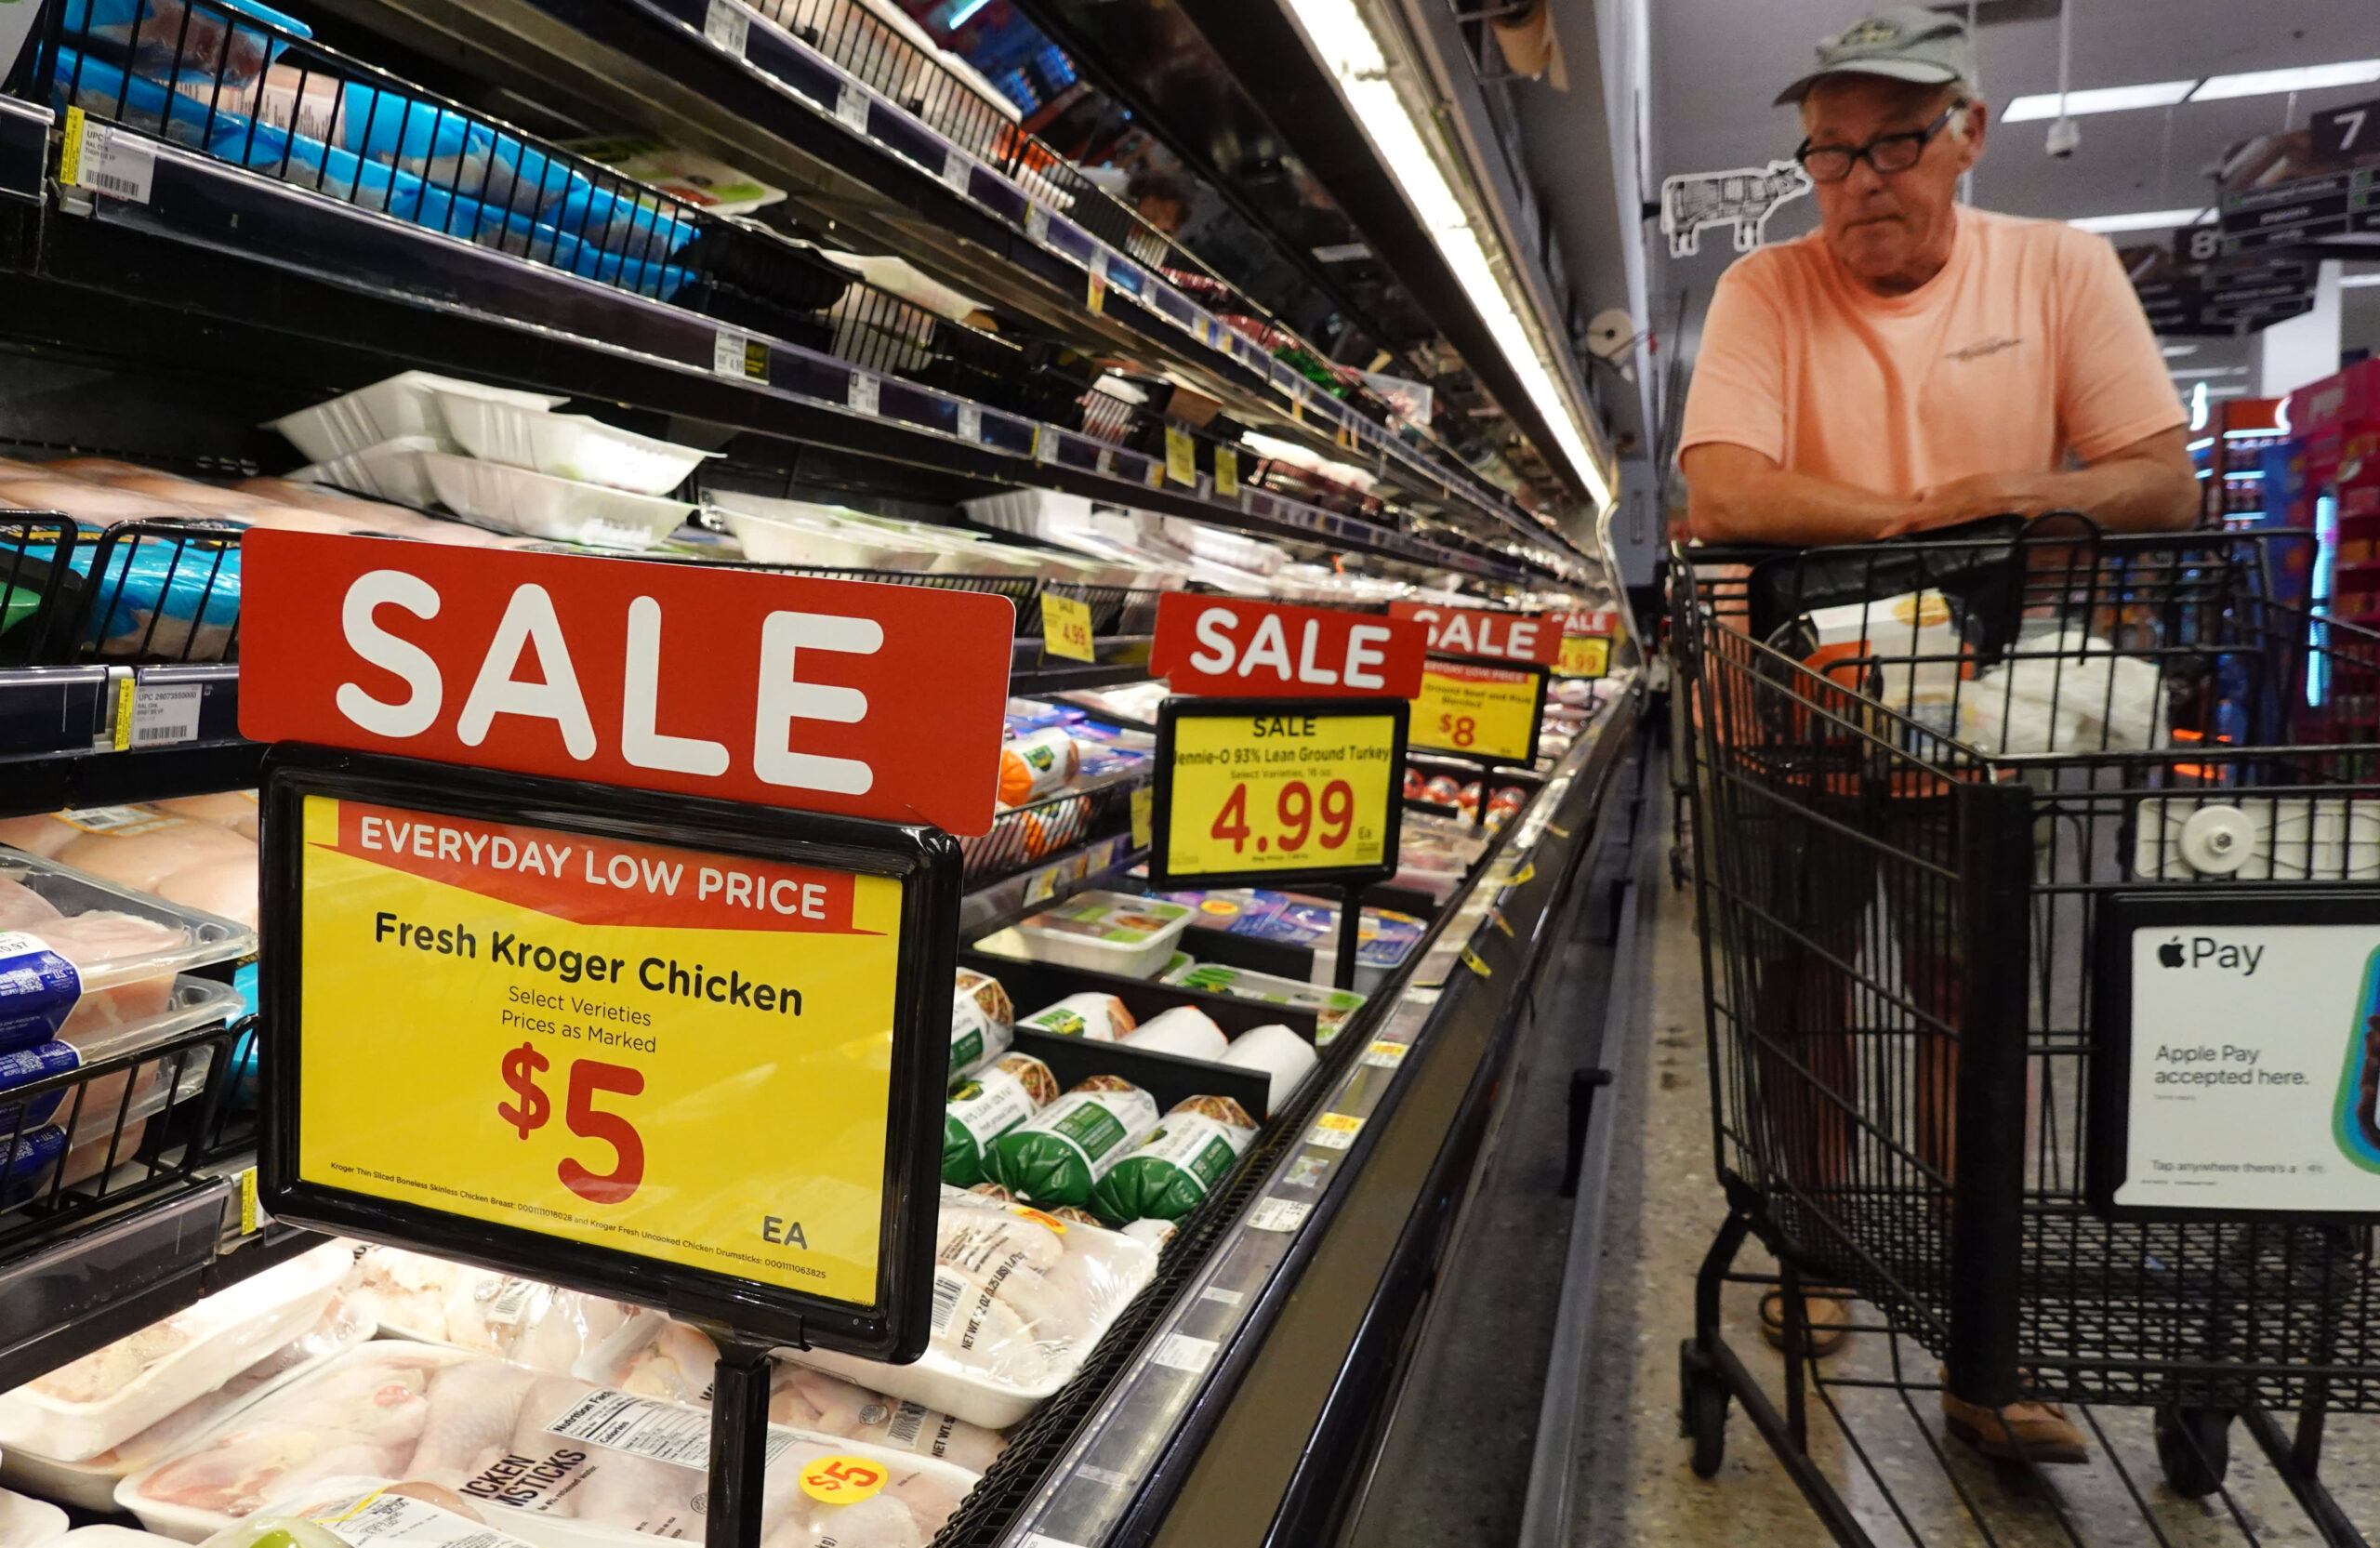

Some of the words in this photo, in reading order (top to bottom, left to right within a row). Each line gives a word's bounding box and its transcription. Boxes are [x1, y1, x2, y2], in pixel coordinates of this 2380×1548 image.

[2333, 110, 2366, 150] 7
[2190, 231, 2217, 259] 8
[1190, 607, 1392, 689] SALE
[139, 693, 153, 701] UPC
[337, 570, 884, 795] SALE
[1252, 717, 1317, 737] SALE
[1439, 713, 1474, 747] $8
[1234, 748, 1261, 763] 93%
[1265, 748, 1295, 762] Lean
[1299, 746, 1344, 762] Ground
[1349, 745, 1390, 762] Turkey
[1210, 779, 1354, 853] 4.99
[362, 815, 572, 879] EVERYDAY
[586, 850, 683, 896] LOW
[699, 867, 826, 920] PRICE
[376, 911, 476, 959] Fresh
[491, 931, 625, 984] Kroger
[639, 957, 802, 1016] Chicken
[2192, 937, 2265, 976] Pay
[509, 986, 564, 1011] Select
[572, 997, 651, 1026] Verieties
[502, 1010, 556, 1035] Prices
[562, 1025, 581, 1039] as
[588, 1025, 656, 1053] Marked
[2155, 1045, 2216, 1065] Apple
[2222, 1045, 2260, 1065] Pay
[2154, 1069, 2253, 1088] accepted
[2258, 1069, 2310, 1086] here.
[497, 1041, 645, 1205] $5
[2152, 1159, 2174, 1172] Tap
[2177, 1162, 2240, 1174] anywhere
[2242, 1163, 2285, 1174] there's
[331, 1162, 354, 1173] Kroger
[357, 1167, 372, 1177] Thin
[373, 1171, 395, 1183] Sliced
[397, 1176, 428, 1190] Boneless
[430, 1183, 458, 1196] Skinless
[460, 1190, 489, 1203] Chicken
[491, 1197, 515, 1209] Breast:
[574, 1216, 588, 1225] and
[590, 1220, 616, 1232] Kroger
[618, 1225, 640, 1238] Fresh
[641, 1231, 681, 1247] Uncooked
[682, 1239, 714, 1253] Chicken
[716, 1247, 762, 1265] Drumsticks:
[762, 1215, 807, 1250] EA
[961, 1330, 974, 1351] NET
[969, 1317, 982, 1334] WT.
[979, 1293, 992, 1308] OZ
[996, 1261, 1012, 1281] LBS)
[553, 1400, 595, 1433] Nutrition
[599, 1421, 629, 1444] Calories
[937, 1423, 953, 1442] WT.
[932, 1440, 947, 1458] NET
[458, 1454, 537, 1499] ICKEN
[807, 1461, 879, 1491] $5
